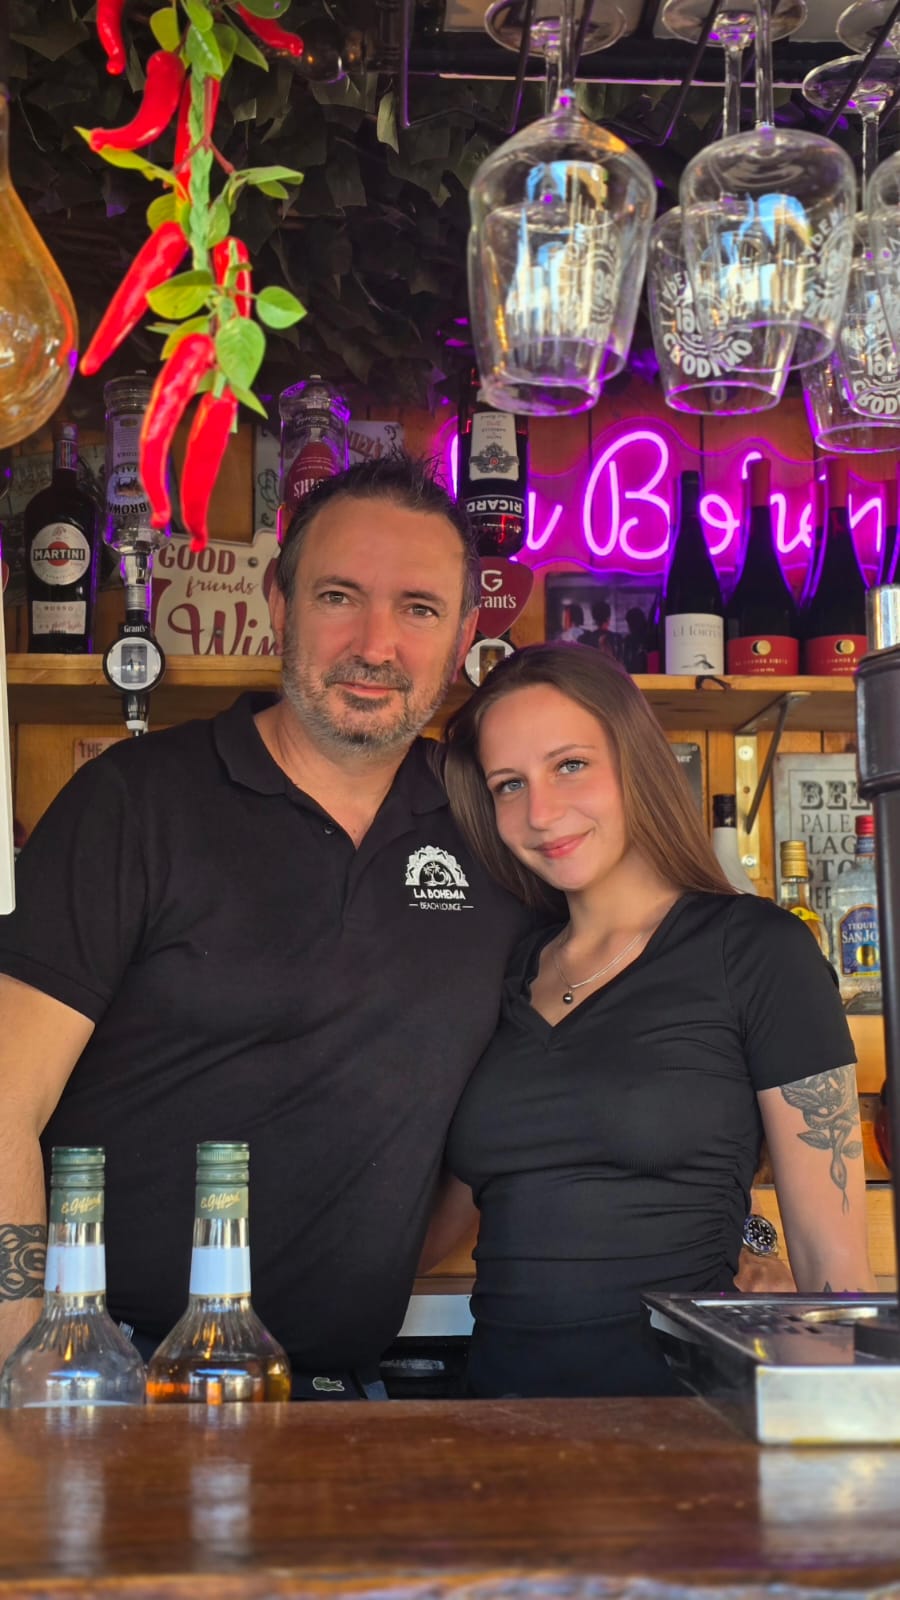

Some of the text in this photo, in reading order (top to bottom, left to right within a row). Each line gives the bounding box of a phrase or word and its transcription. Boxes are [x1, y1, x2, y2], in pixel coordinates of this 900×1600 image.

[466, 499, 522, 513] RICARD
[34, 549, 84, 560] MARTINI
[158, 543, 236, 575] GOOD
[186, 576, 258, 598] friends
[167, 601, 281, 656] Win
[78, 740, 102, 758] THE
[799, 781, 870, 810] BEE
[801, 814, 852, 833] PALE
[808, 835, 857, 855] LAG
[413, 888, 466, 900] LA BOHEMIA
